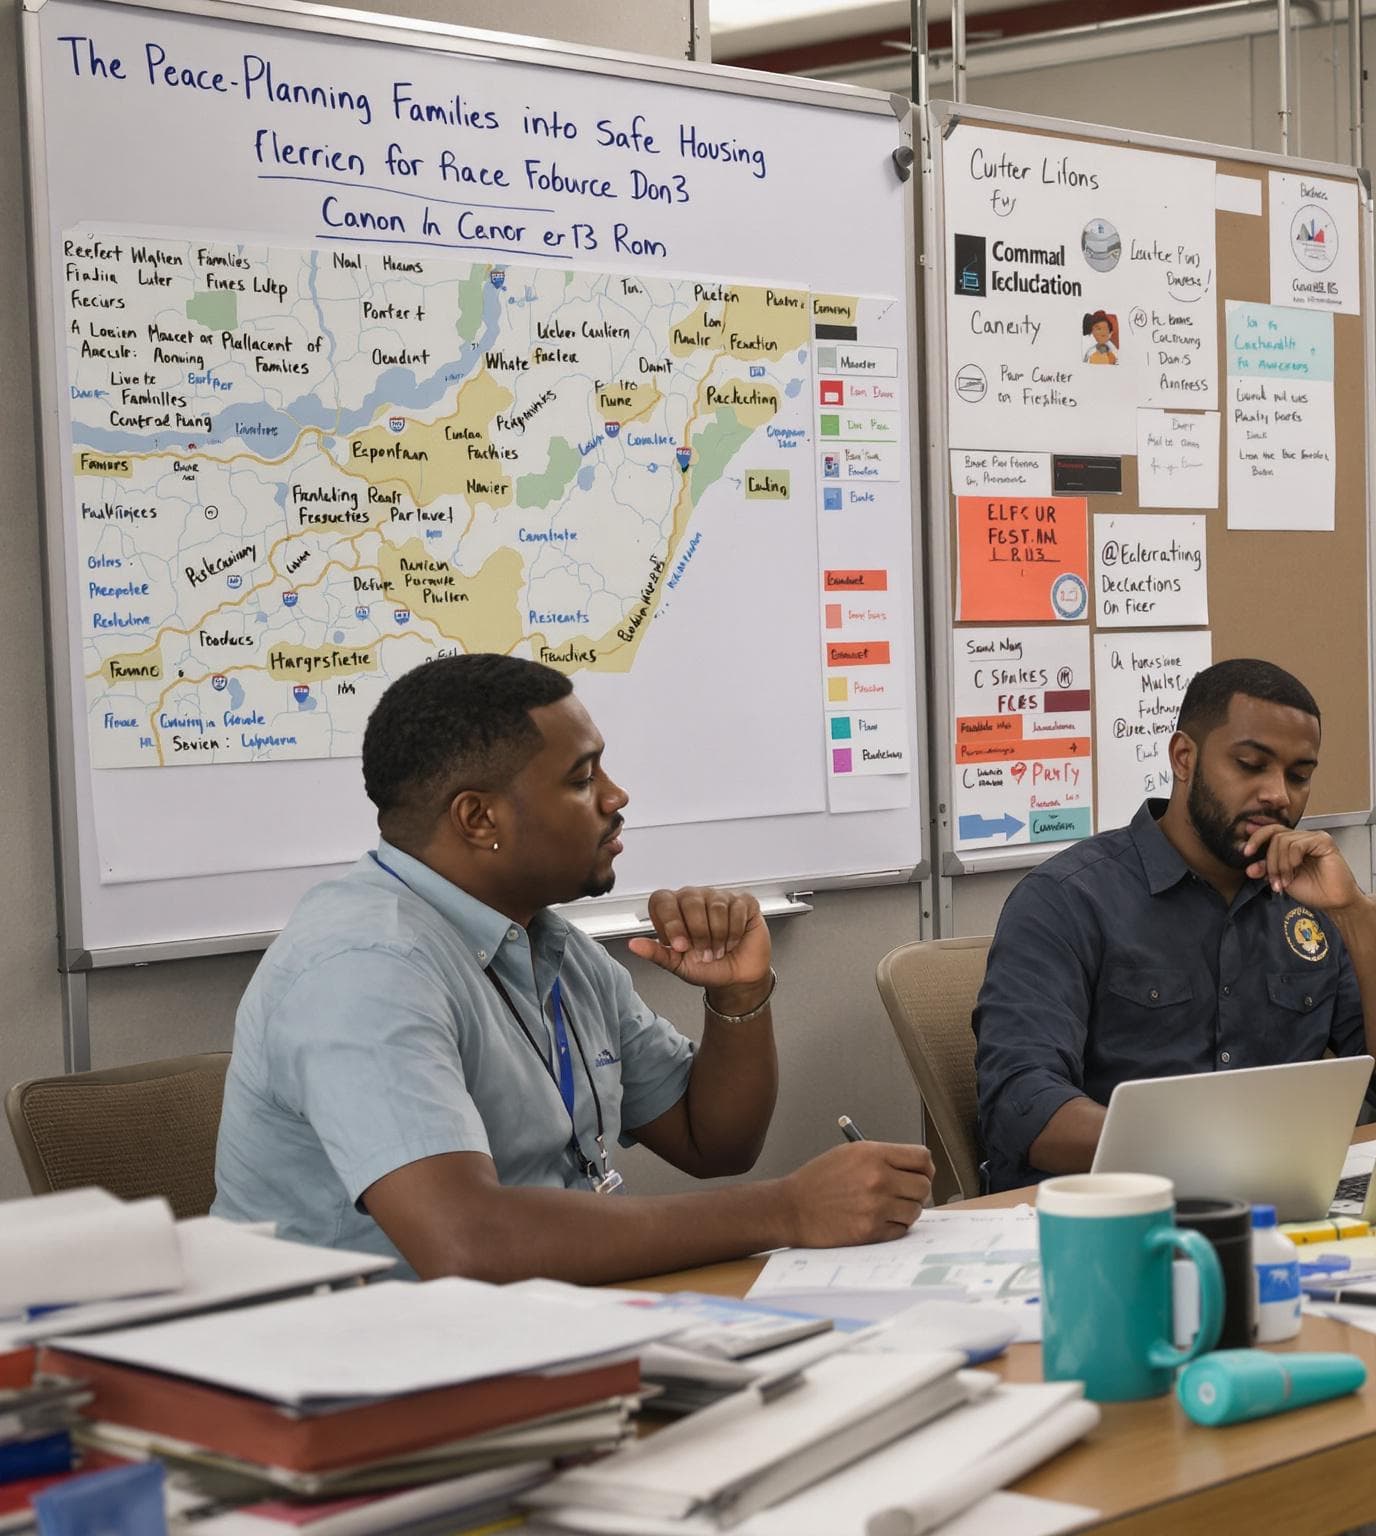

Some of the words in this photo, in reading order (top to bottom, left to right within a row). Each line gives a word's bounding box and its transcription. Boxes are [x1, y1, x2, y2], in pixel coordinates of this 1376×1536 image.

[56, 36, 127, 80] The
[145, 42, 372, 125] Peace-Planning
[392, 82, 500, 130] Families
[523, 105, 578, 140] into
[596, 115, 661, 154] Safe
[679, 124, 766, 179] Housing
[384, 142, 425, 177] for
[322, 195, 406, 233] Canon
